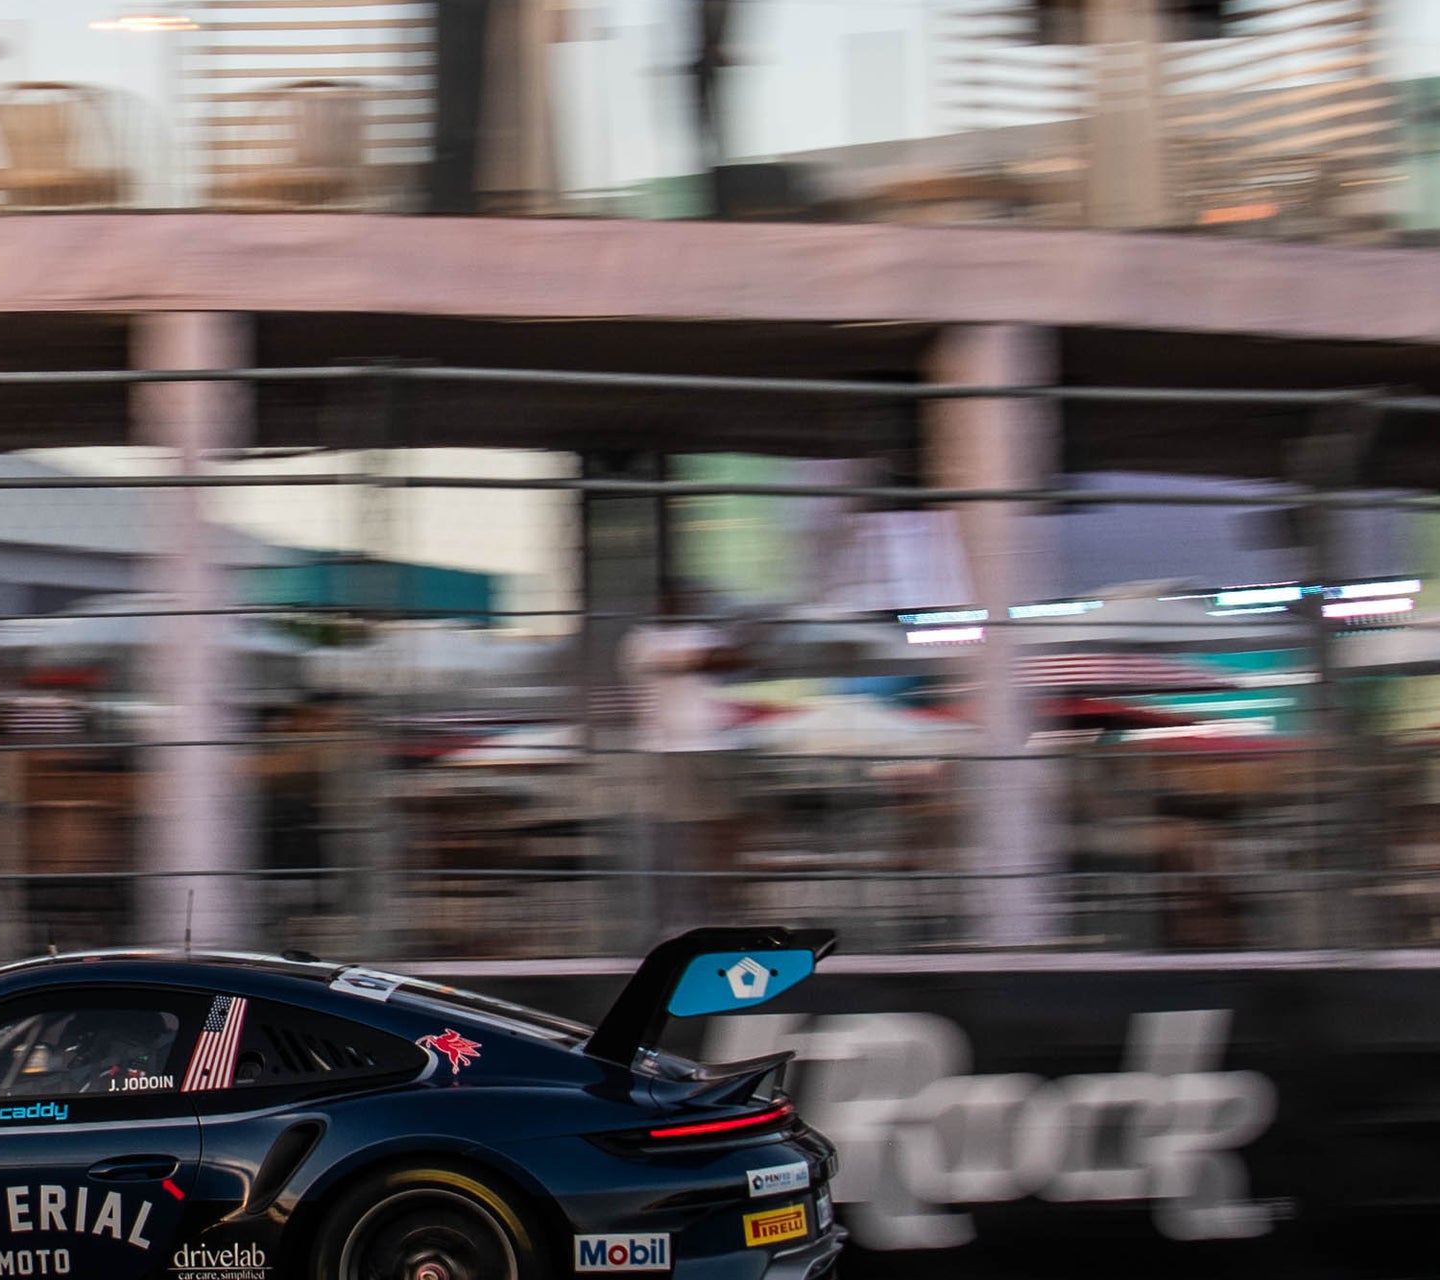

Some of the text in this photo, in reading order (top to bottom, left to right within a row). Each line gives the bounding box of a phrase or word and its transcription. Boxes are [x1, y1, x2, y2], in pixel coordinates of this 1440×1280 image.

[108, 1075, 174, 1092] J. JODOIN
[777, 1011, 1280, 1248] Rock
[751, 1211, 803, 1238] PIRELLI
[173, 1242, 266, 1267] drivelab
[579, 1238, 665, 1266] Mobil
[178, 1271, 194, 1280] car
